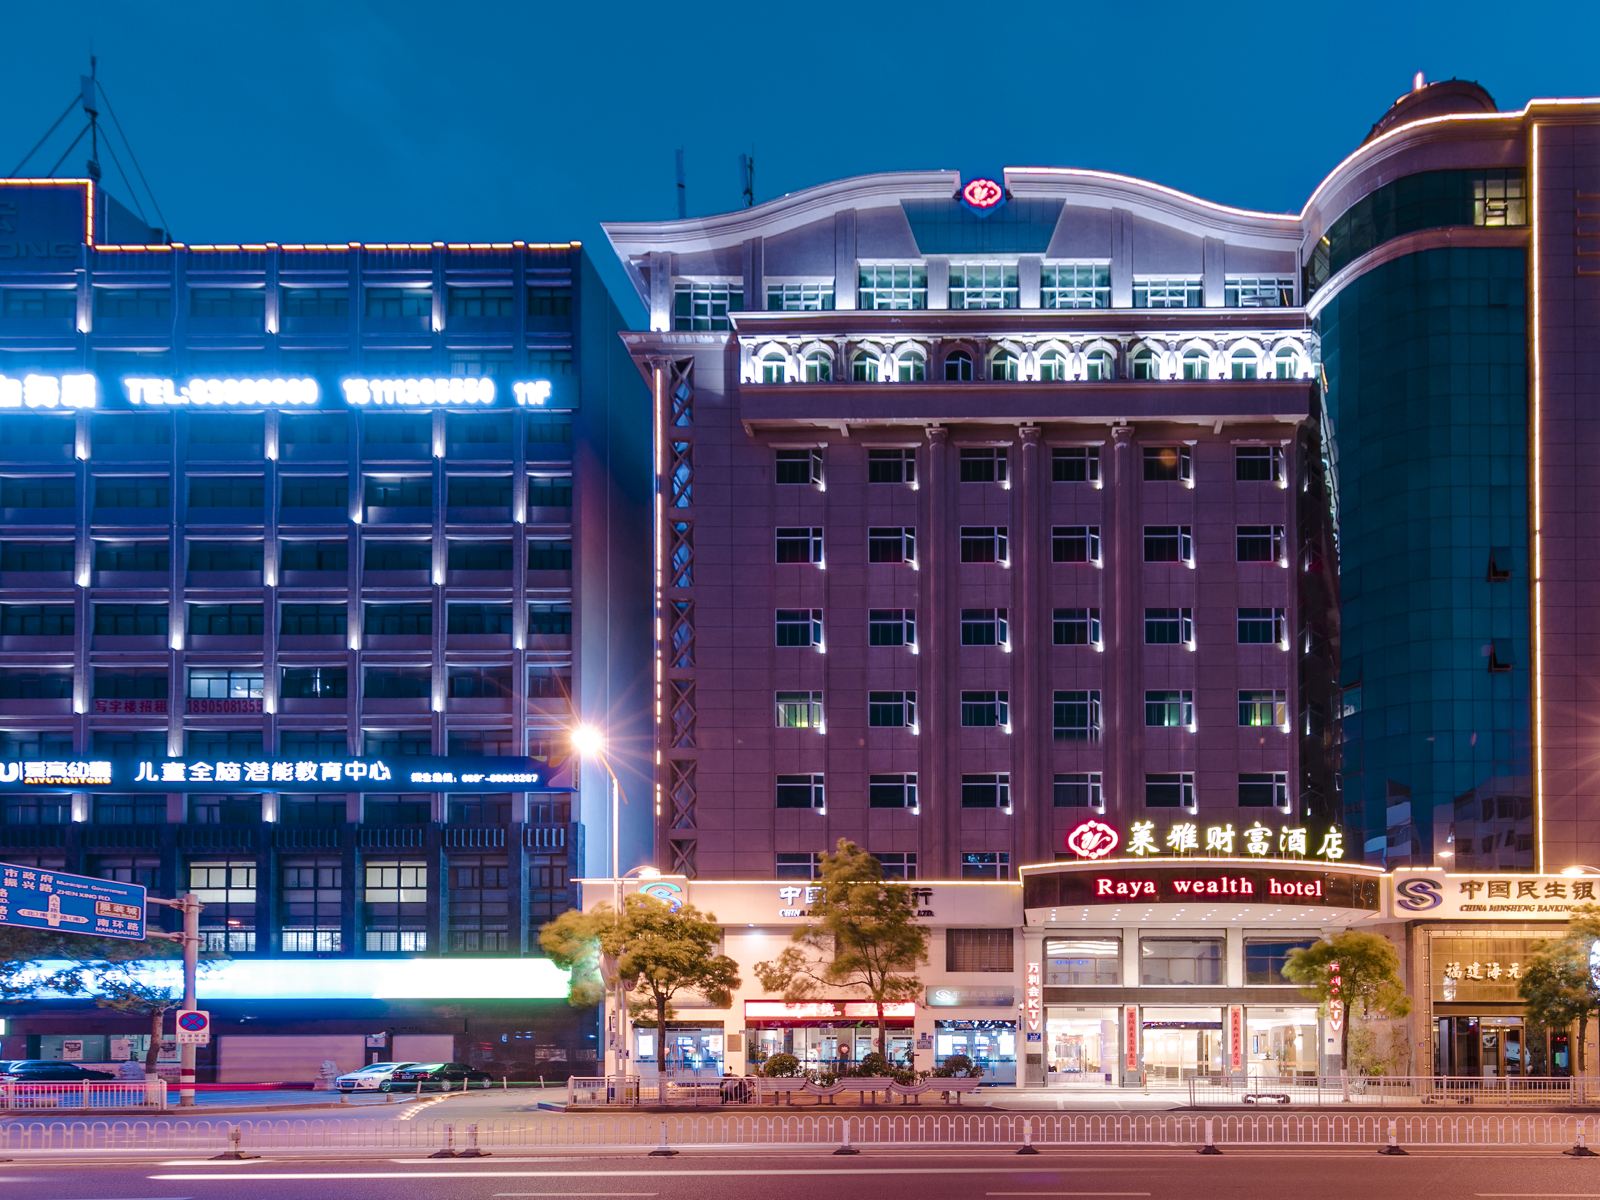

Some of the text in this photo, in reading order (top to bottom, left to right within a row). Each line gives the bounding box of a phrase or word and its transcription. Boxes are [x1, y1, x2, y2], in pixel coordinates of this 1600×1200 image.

[95, 700, 167, 712] 写字楼招租
[134, 760, 391, 782] 儿童全脑潜能教育中心
[1126, 820, 1345, 859] 莱雅财富酒店
[4, 868, 53, 883] 市政府
[3, 877, 53, 893] 振兴路
[1097, 877, 1322, 898] Raya wealth hotel
[56, 889, 78, 897] ZHEN
[1459, 904, 1487, 912] CHINA
[1488, 904, 1535, 912] MINSHENG
[97, 918, 139, 931] 南环路
[1027, 962, 1040, 1031] 万利会KTV
